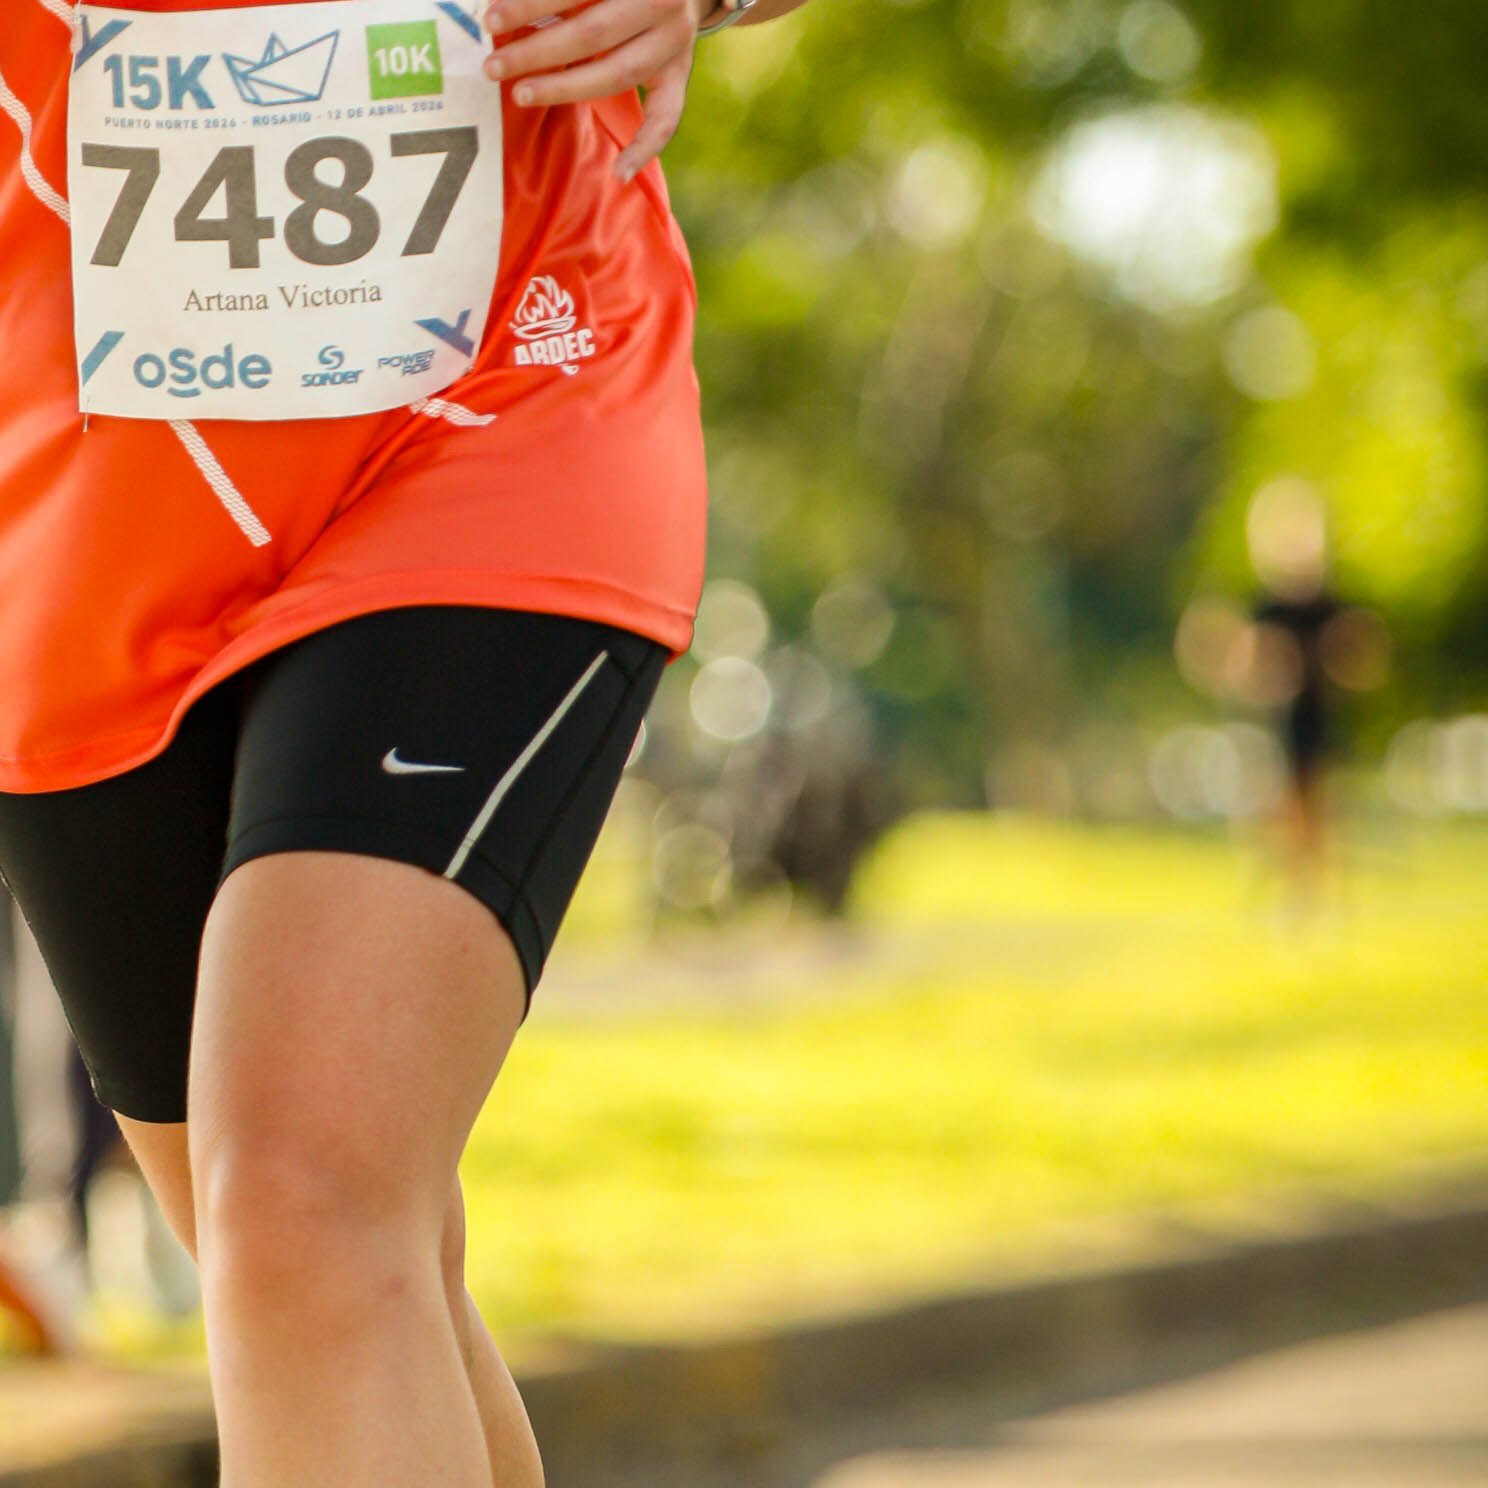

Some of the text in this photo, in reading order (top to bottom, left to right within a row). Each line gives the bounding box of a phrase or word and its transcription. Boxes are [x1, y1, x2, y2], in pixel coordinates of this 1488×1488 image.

[374, 41, 435, 78] 10K
[103, 53, 215, 111] 15K
[104, 116, 151, 129] PUERTO
[155, 119, 199, 130] NORTE
[204, 118, 237, 129] 2026
[252, 112, 311, 127] ROSARIO
[327, 109, 342, 120] 12
[347, 106, 363, 118] DE
[368, 102, 407, 116] ABRIL
[80, 125, 479, 270] 7487
[183, 281, 383, 313] Artana Victoria
[377, 349, 436, 369] POWER
[513, 328, 597, 366] ARDEC
[132, 342, 272, 390] osde
